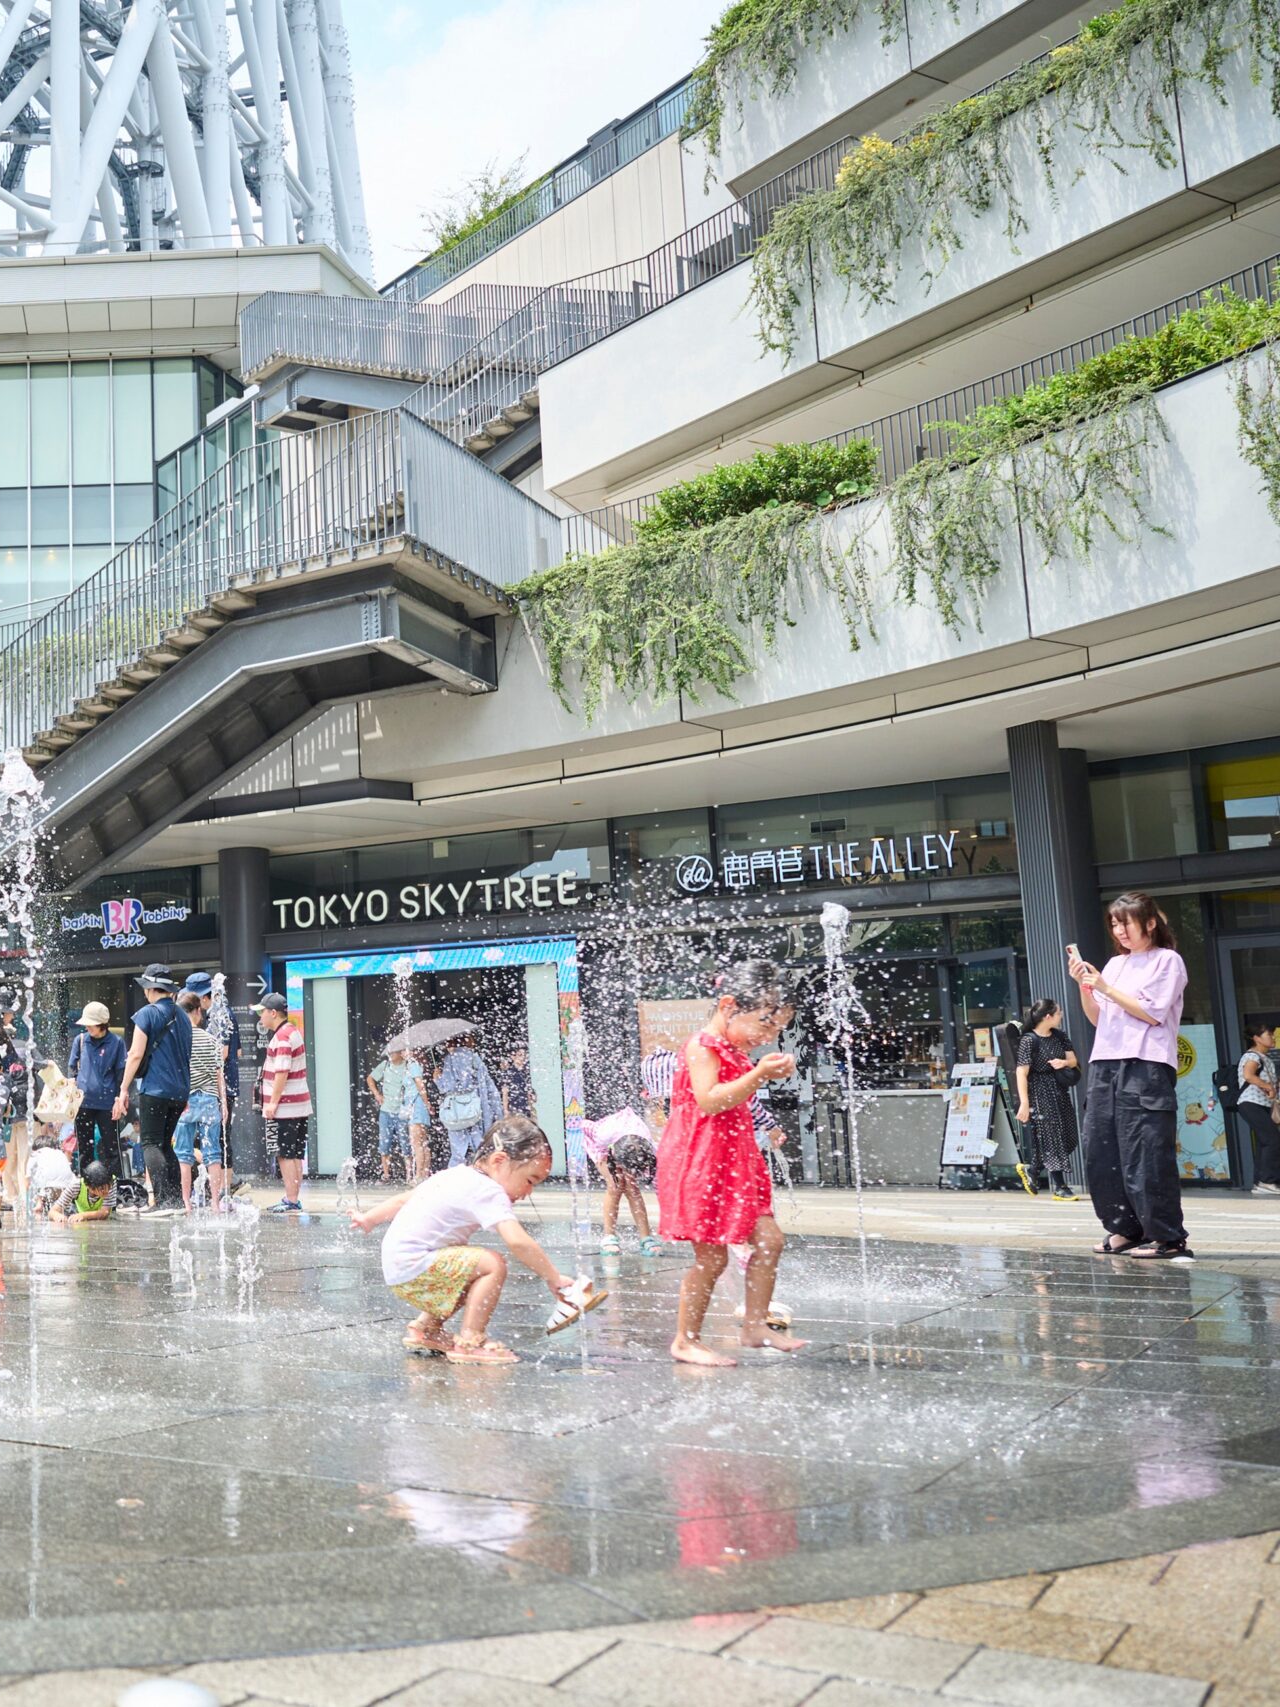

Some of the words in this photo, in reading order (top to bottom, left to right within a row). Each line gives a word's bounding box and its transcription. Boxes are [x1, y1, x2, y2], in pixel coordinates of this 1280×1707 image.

[723, 848, 804, 887] 鹿角巷
[809, 842, 862, 880] THE
[870, 832, 955, 875] ALLEY
[61, 913, 102, 931] baskin
[101, 898, 143, 934] BR
[143, 907, 187, 924] robbins
[273, 889, 388, 929] TOKYO
[400, 871, 579, 919] SKYTREE
[101, 934, 146, 949] サーティワン
